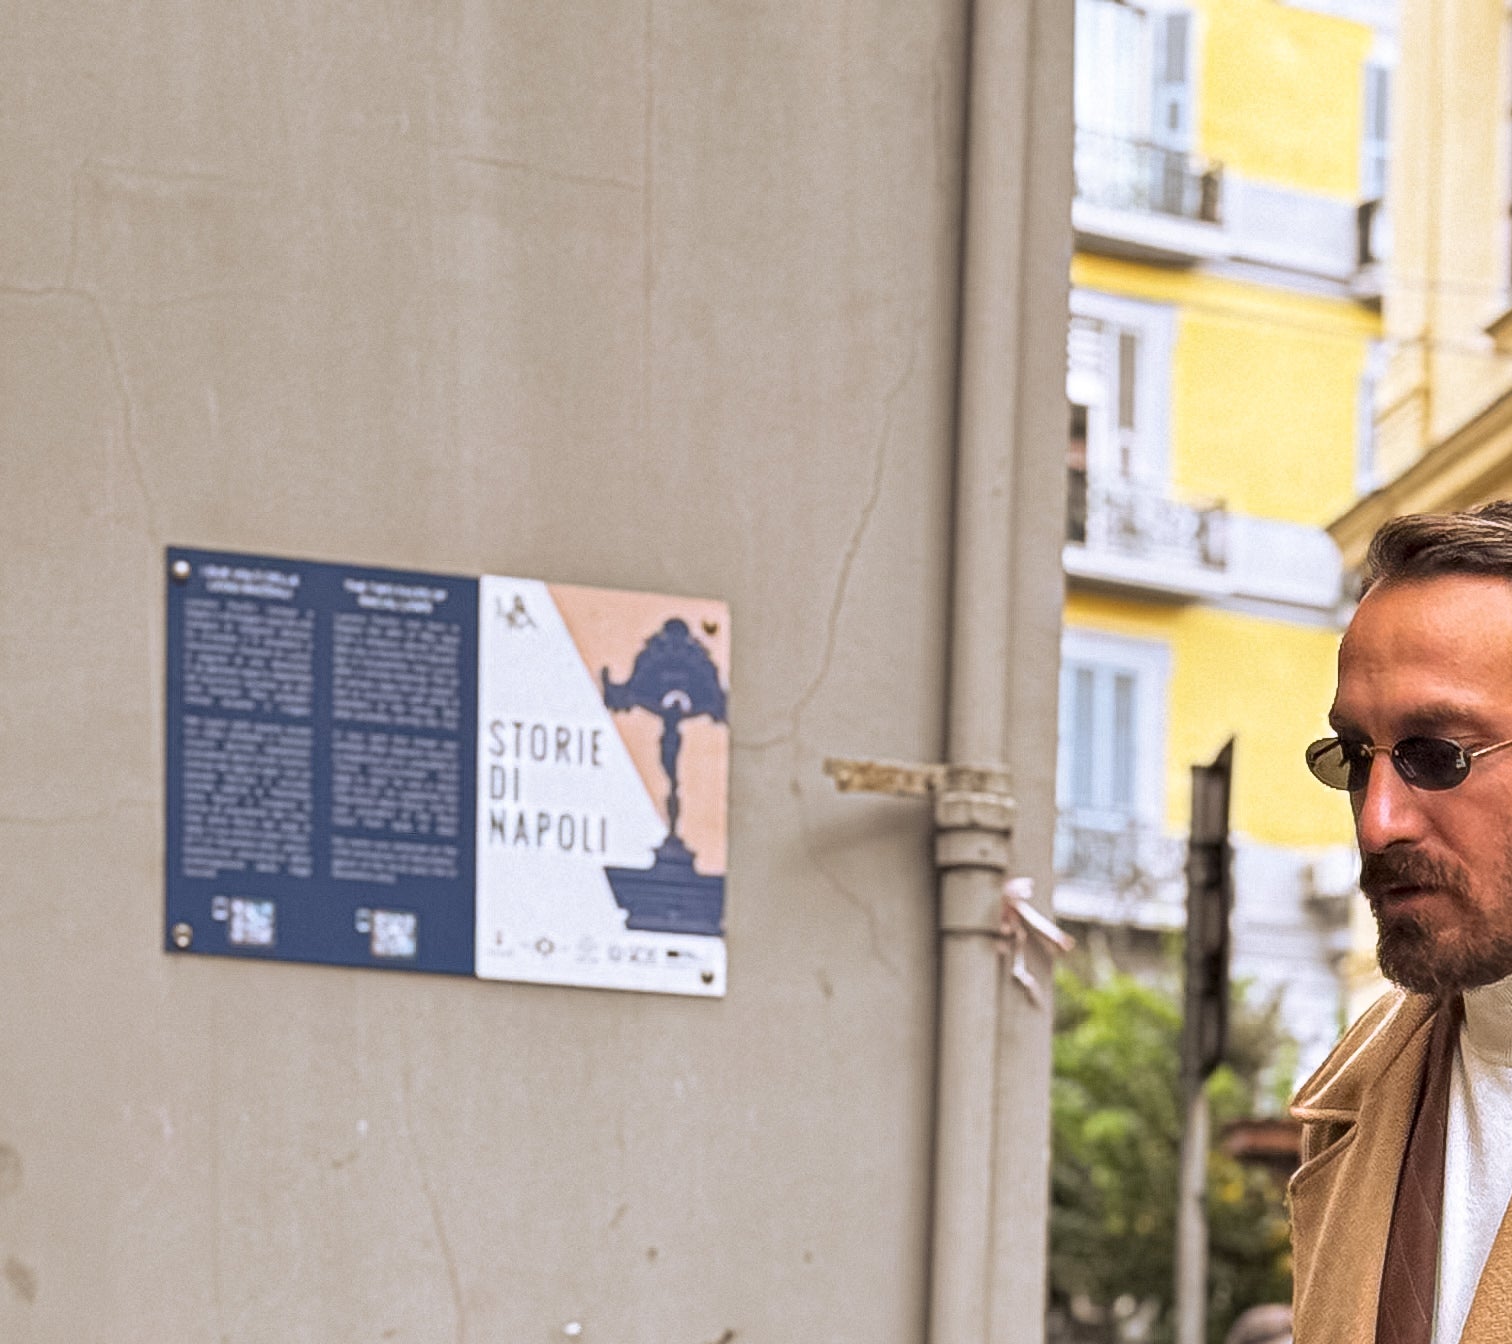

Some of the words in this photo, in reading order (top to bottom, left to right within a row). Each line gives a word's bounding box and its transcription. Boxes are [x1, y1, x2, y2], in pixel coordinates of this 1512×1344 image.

[489, 719, 602, 766] STORIE
[489, 764, 519, 803] DI
[489, 808, 606, 853] NAPOLI
